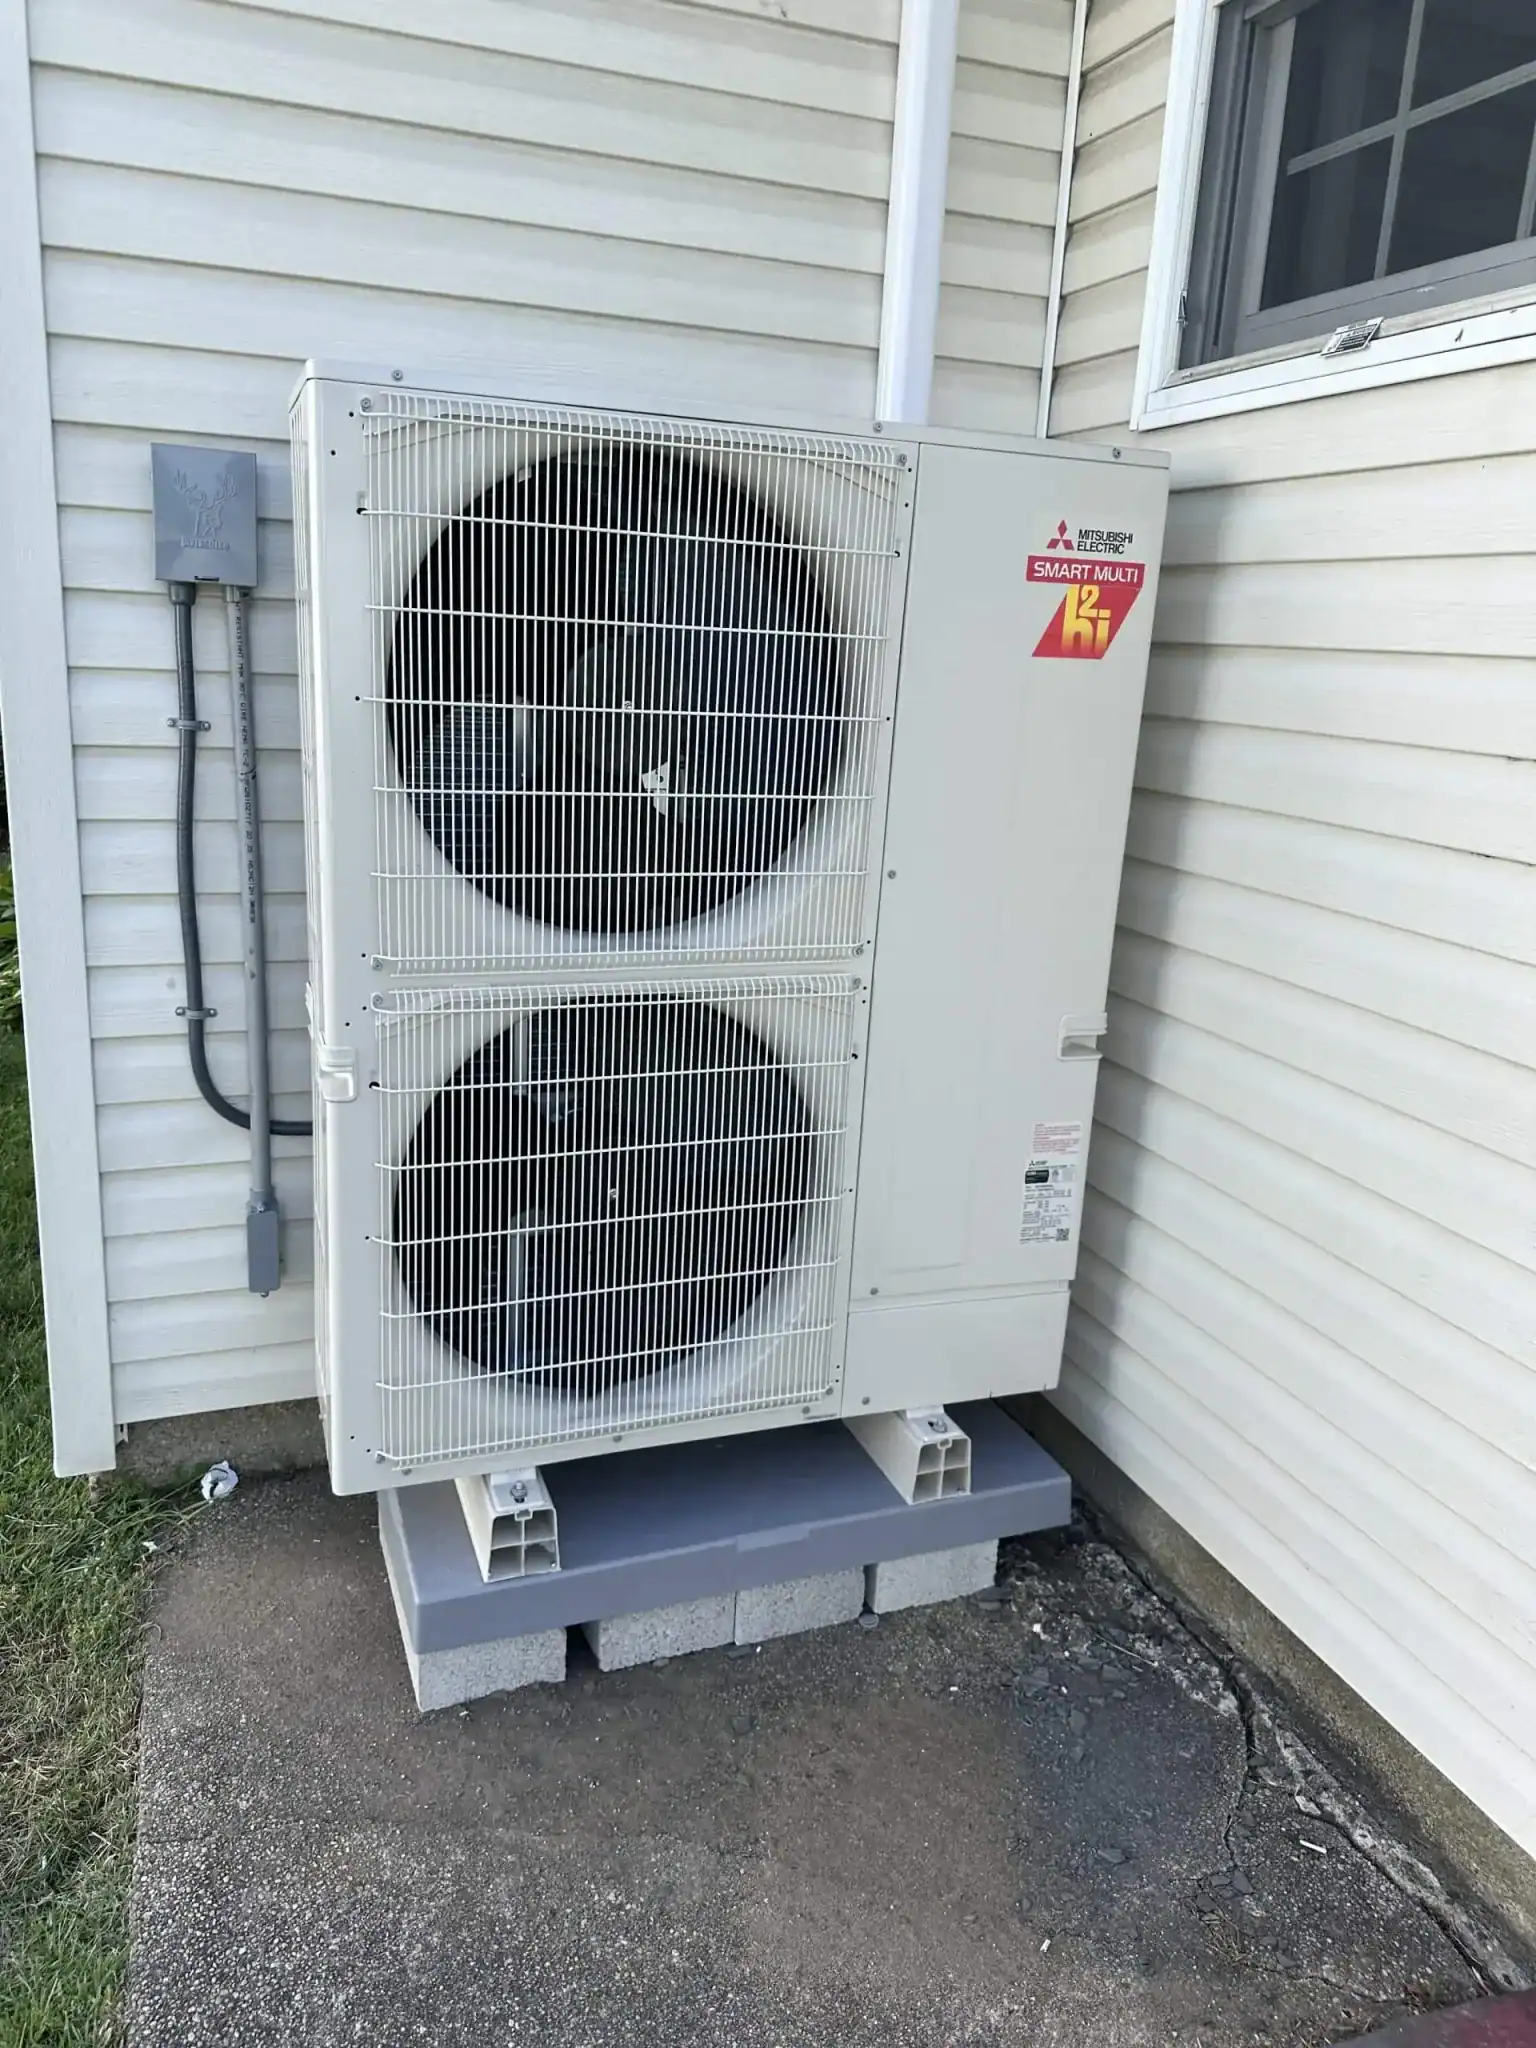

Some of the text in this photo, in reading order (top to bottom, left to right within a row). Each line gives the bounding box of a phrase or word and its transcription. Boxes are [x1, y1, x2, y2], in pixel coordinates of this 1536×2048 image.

[1078, 529, 1133, 543] MITSUBISHI
[1077, 541, 1125, 554] ELECTRIC
[1034, 562, 1138, 583] SMART MULTI
